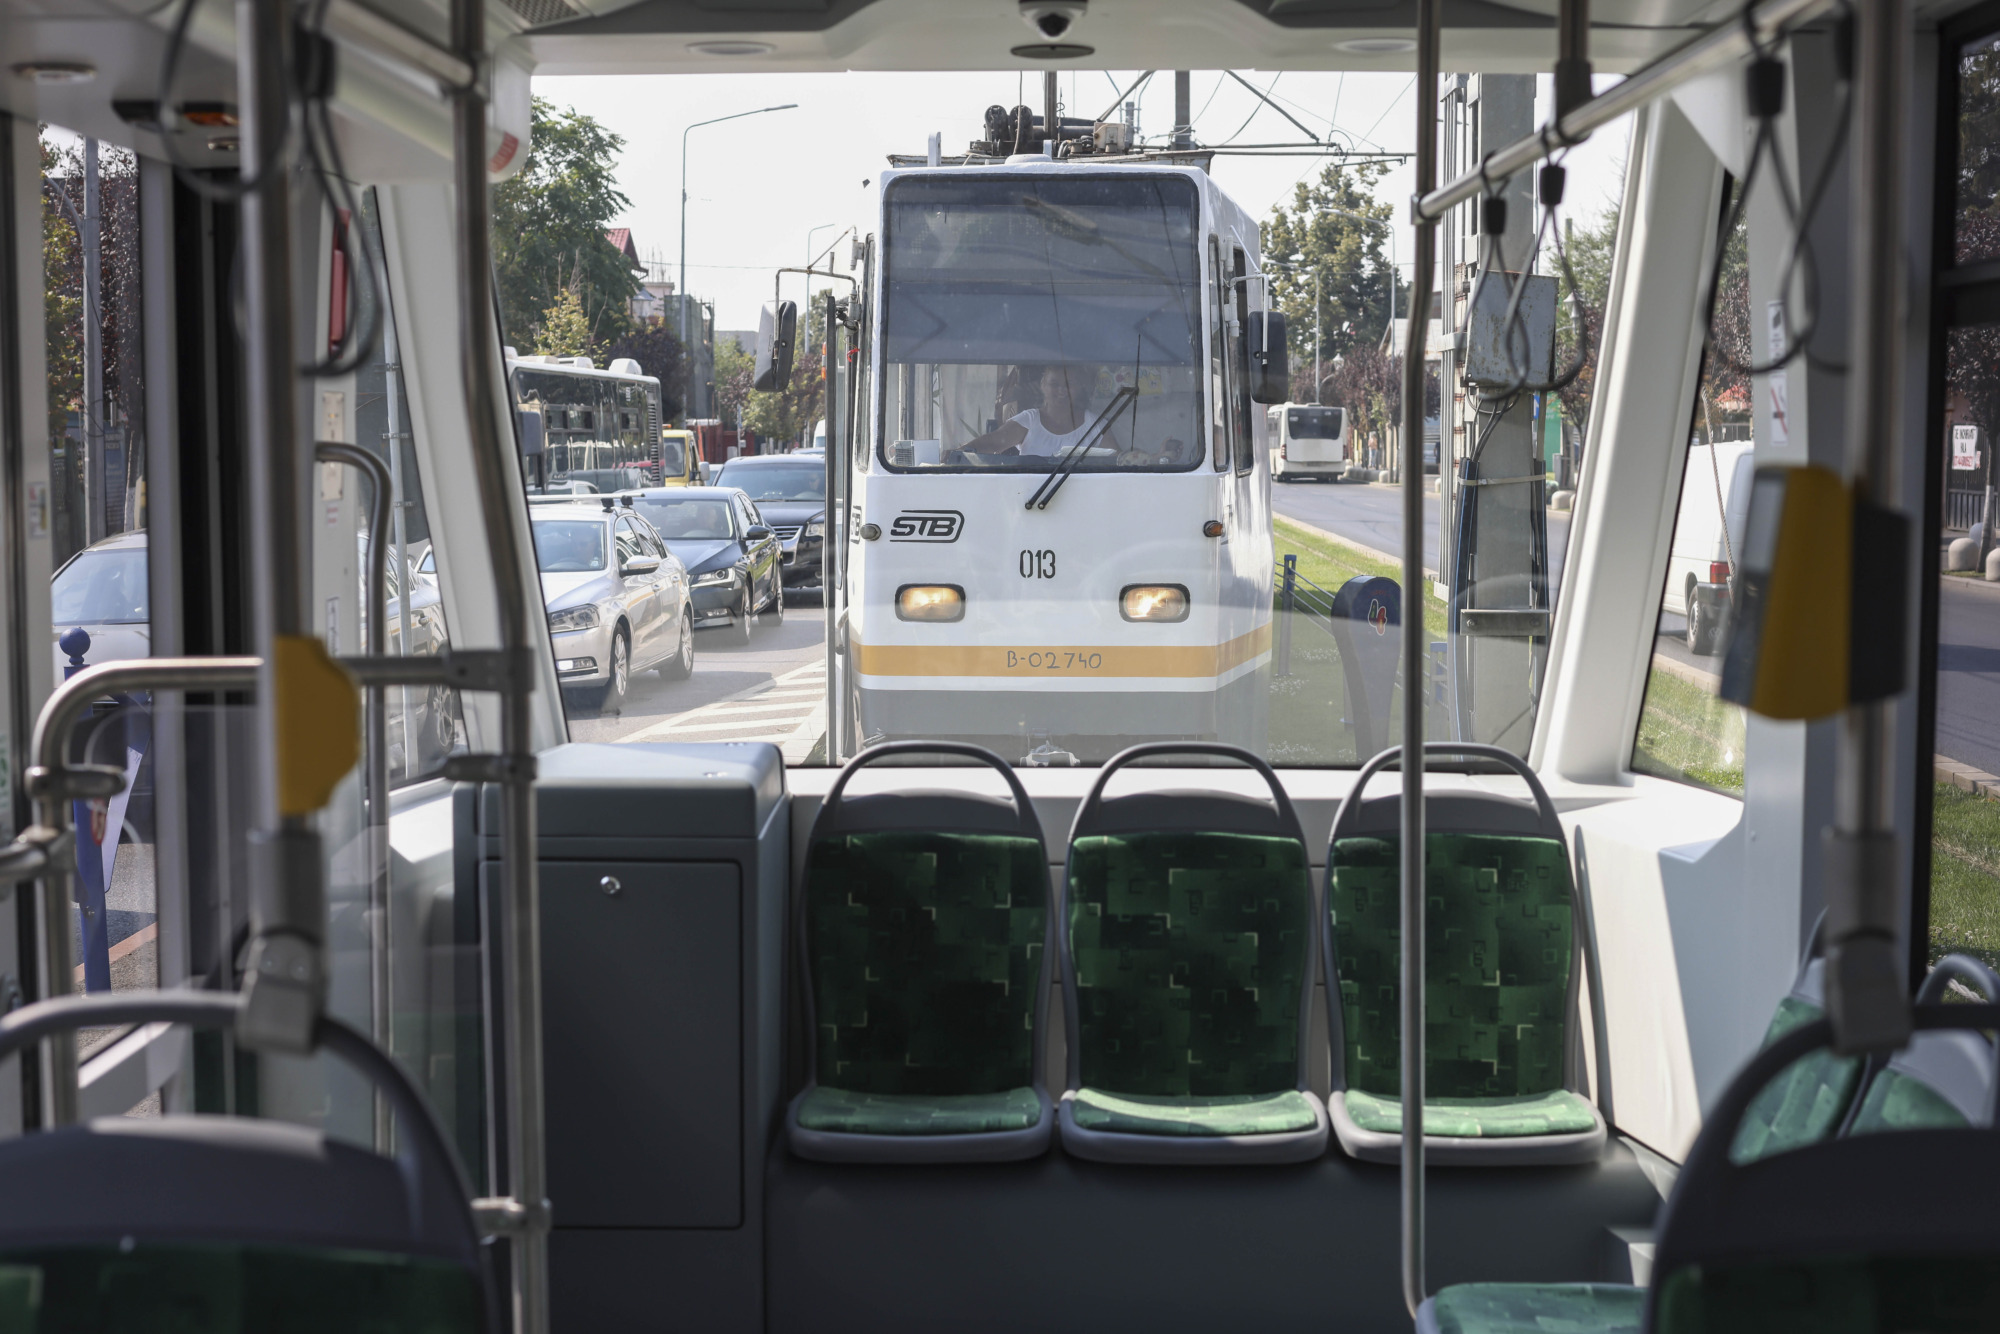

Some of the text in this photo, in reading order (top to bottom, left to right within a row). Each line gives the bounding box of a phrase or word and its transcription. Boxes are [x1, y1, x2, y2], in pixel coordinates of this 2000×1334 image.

[890, 515, 958, 537] STB
[1019, 549, 1056, 579] 013
[1007, 650, 1102, 669] B-02740
